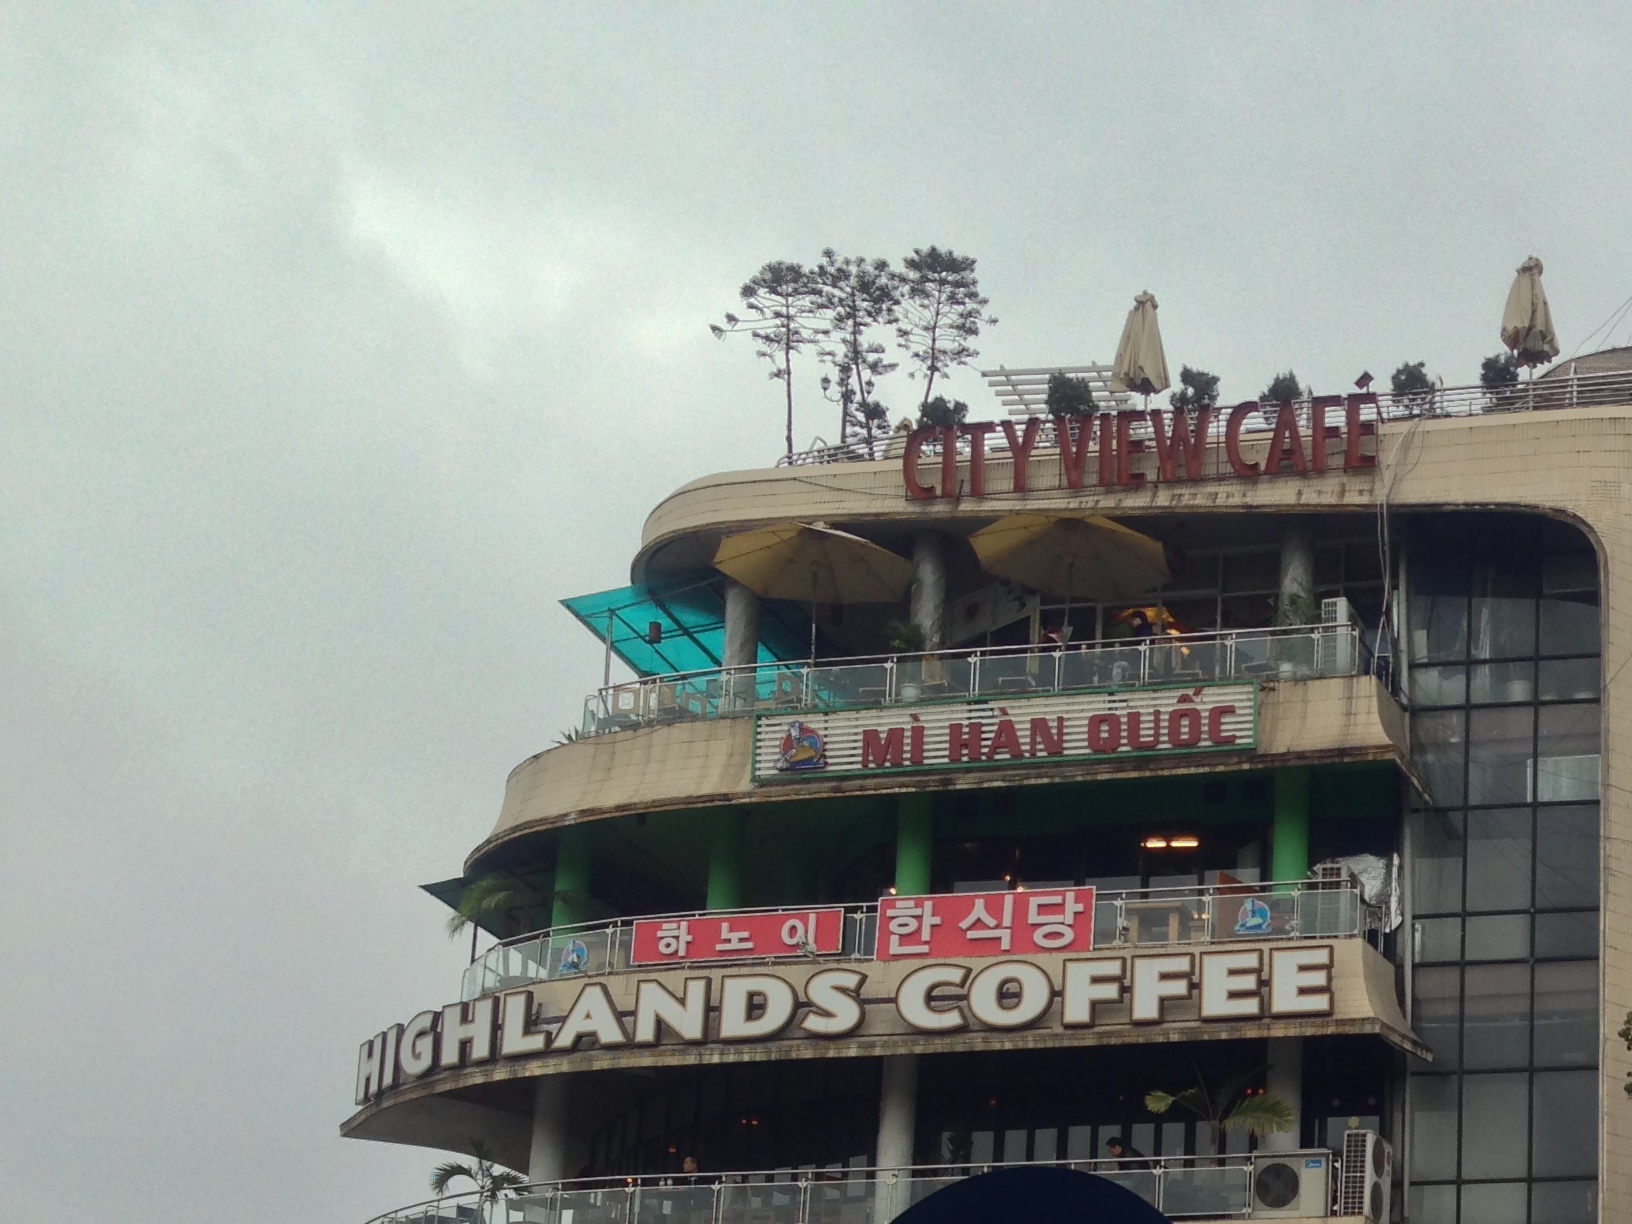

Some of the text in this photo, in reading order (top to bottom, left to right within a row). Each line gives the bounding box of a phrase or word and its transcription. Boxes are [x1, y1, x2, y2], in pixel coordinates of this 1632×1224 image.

[902, 418, 1041, 500] CITY
[1056, 404, 1213, 489] VIEW
[861, 686, 1237, 767] MÌ HÀN QUỐC
[656, 913, 818, 957] 하노이
[886, 890, 1084, 955] 한식당
[354, 945, 1334, 1106] HIGHLANDS COFFEE
